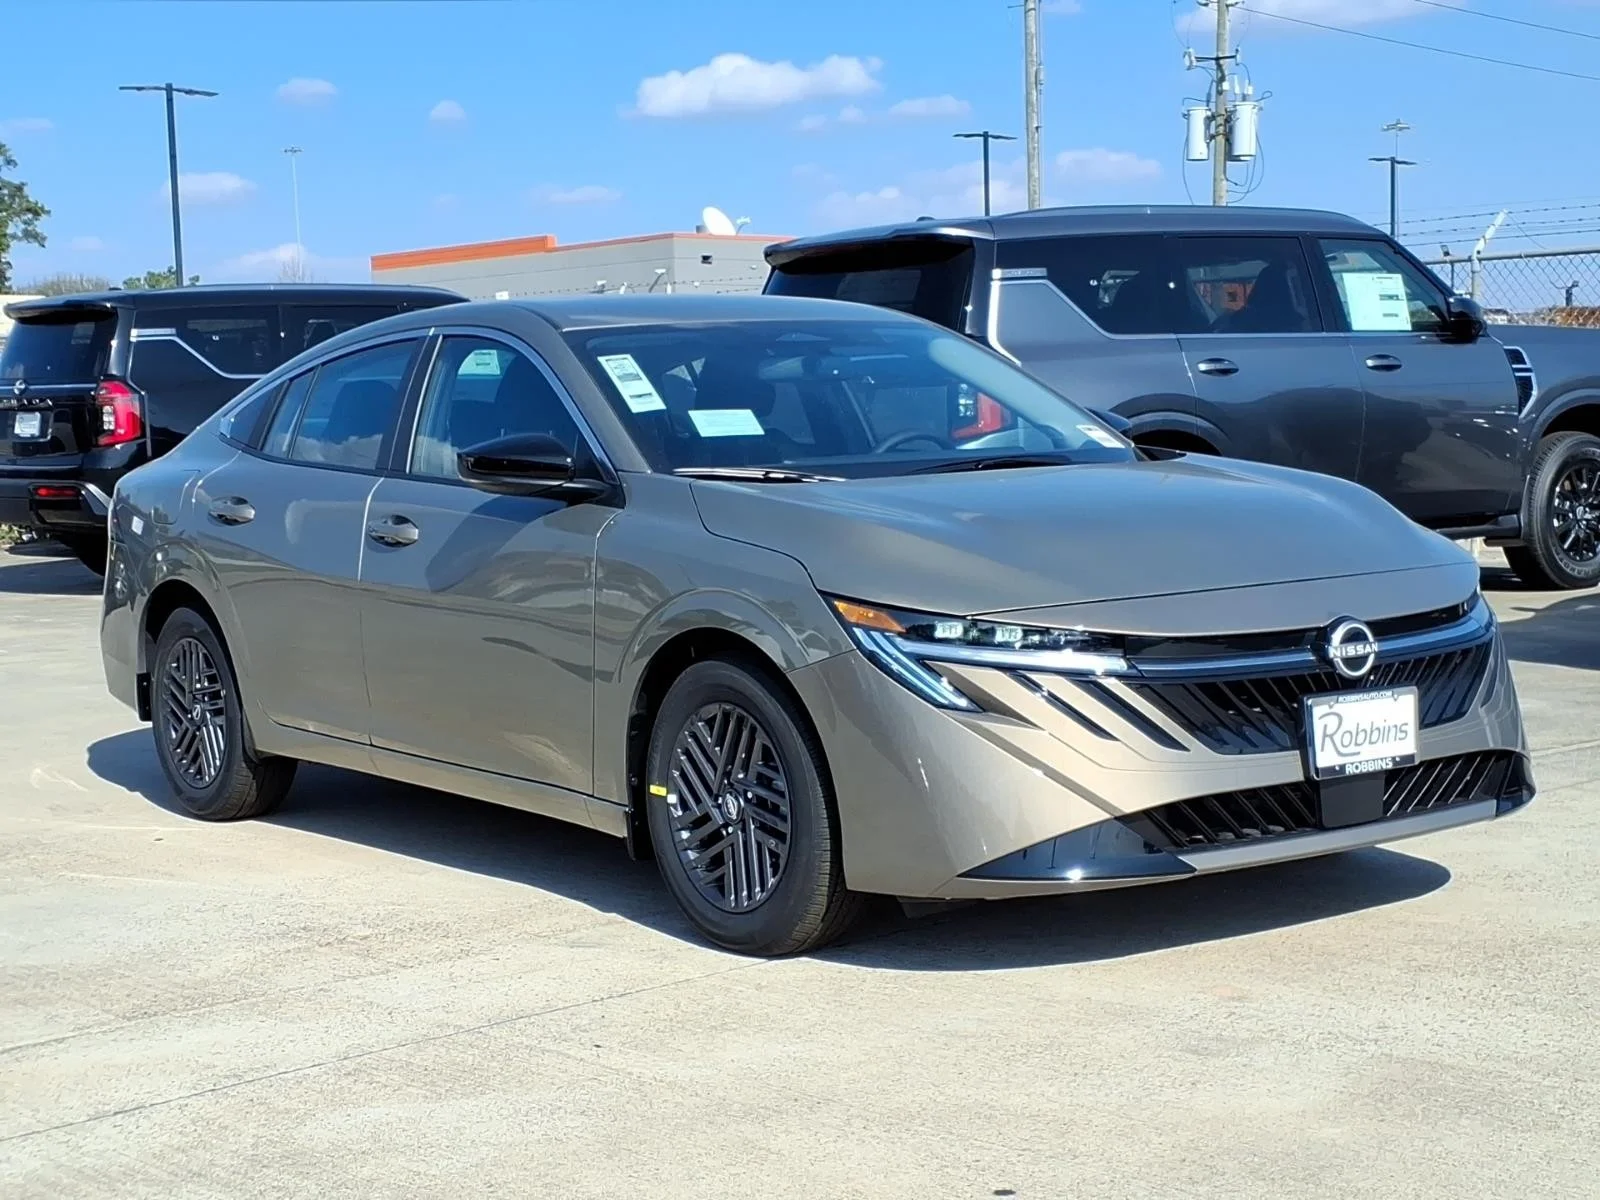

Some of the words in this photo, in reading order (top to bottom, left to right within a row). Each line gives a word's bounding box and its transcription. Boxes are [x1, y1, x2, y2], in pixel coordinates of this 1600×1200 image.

[1328, 641, 1378, 659] NISSAN
[1318, 711, 1409, 757] Robbins
[1345, 758, 1393, 775] ROBBINS
